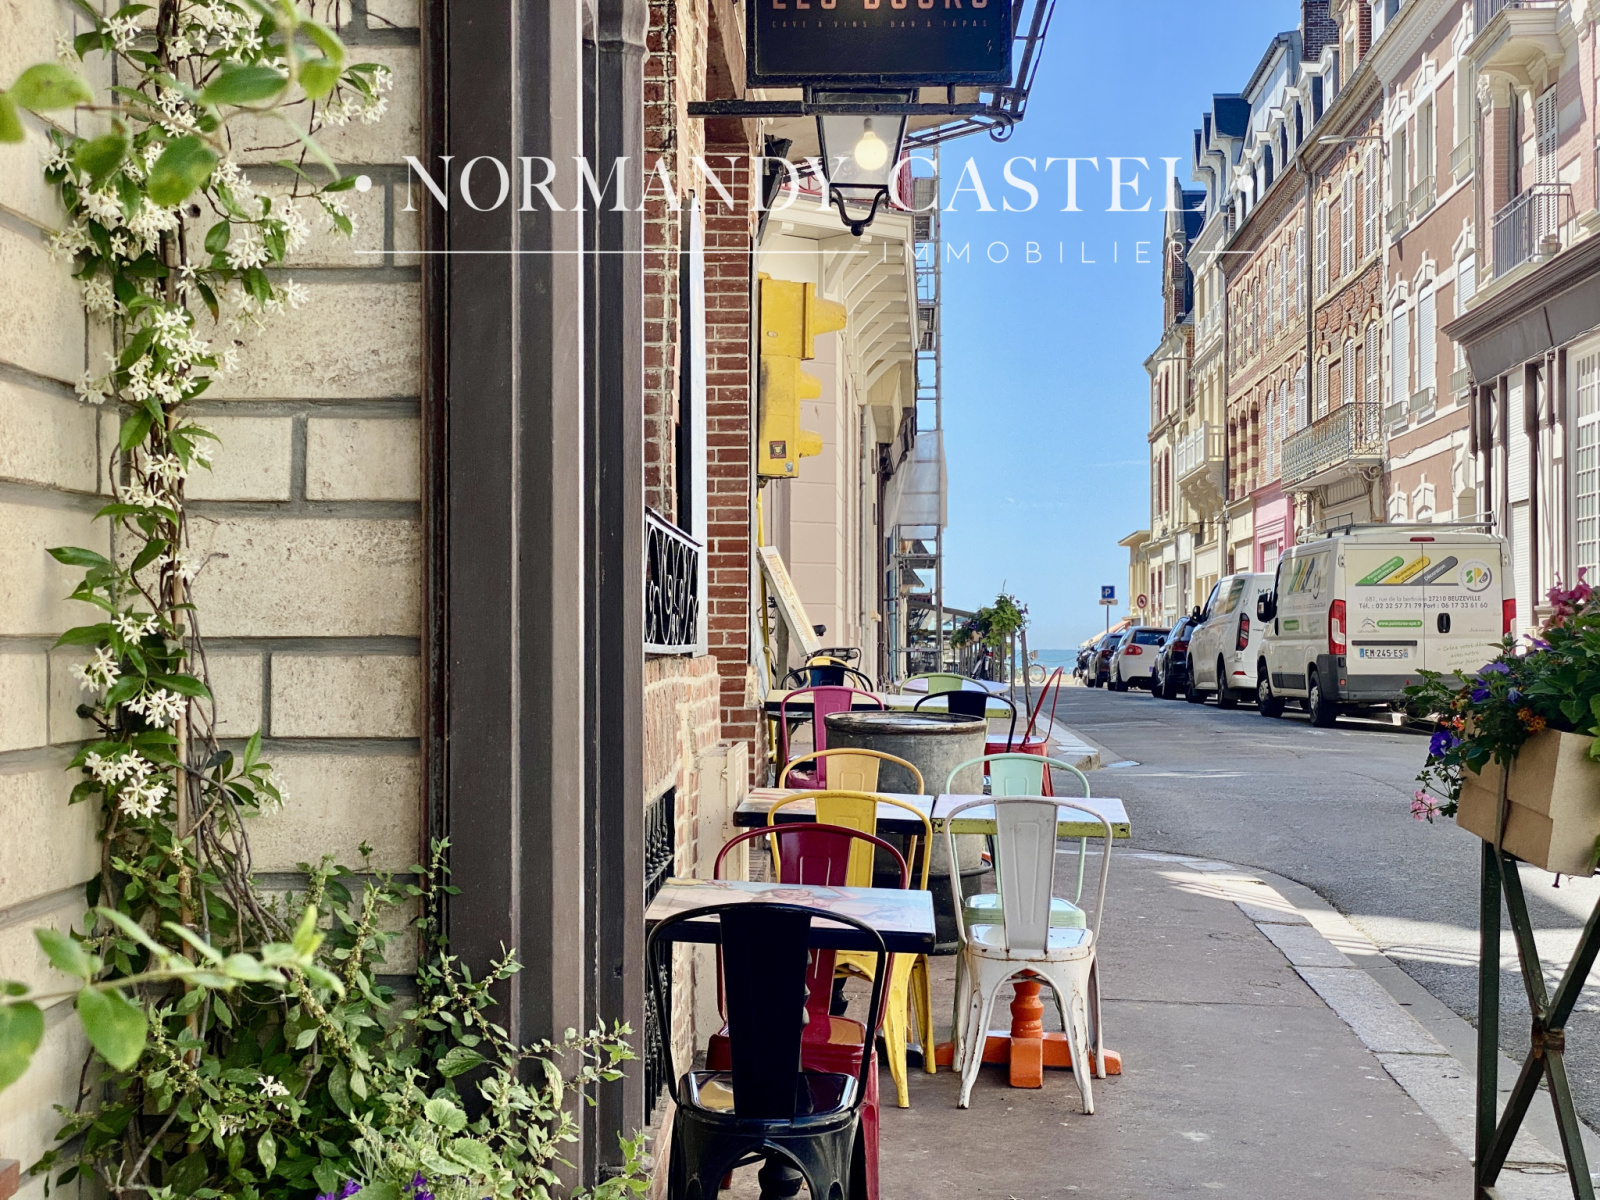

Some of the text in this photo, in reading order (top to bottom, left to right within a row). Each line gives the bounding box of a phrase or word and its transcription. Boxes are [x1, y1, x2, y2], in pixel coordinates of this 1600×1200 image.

[772, 20, 806, 28] CAVE
[834, 20, 867, 28] VINS
[890, 20, 915, 28] BAR
[943, 19, 987, 27] TAPAS
